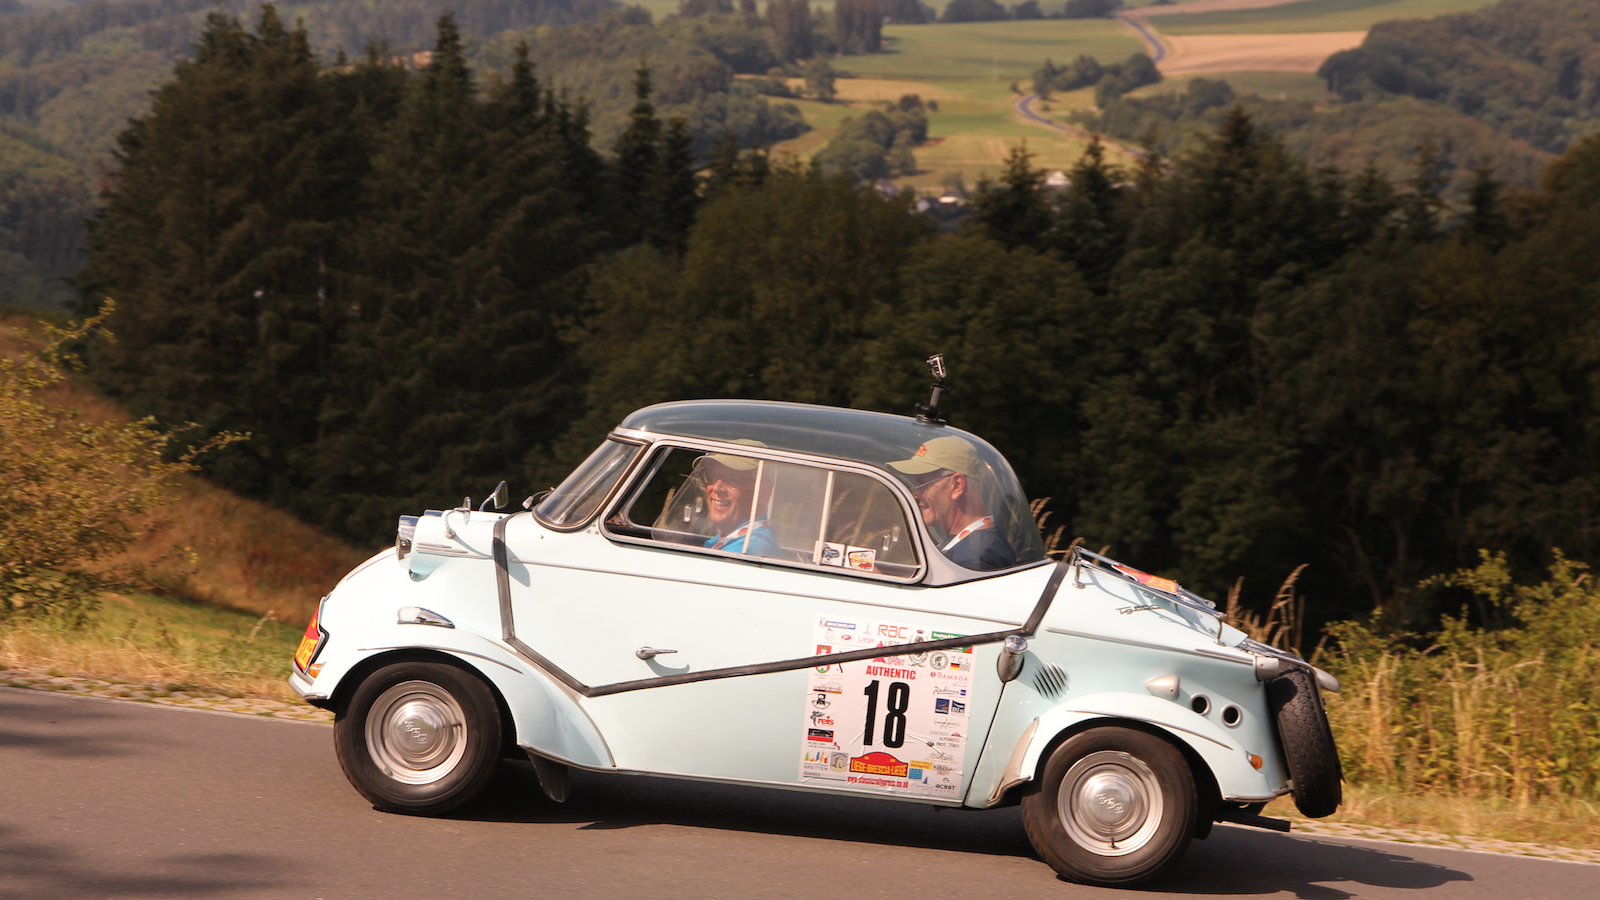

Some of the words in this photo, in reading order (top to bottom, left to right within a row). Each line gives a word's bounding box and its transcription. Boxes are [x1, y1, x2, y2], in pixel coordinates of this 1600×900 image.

[866, 665, 916, 680] AUTHENTIC
[937, 672, 968, 681] RAMADA
[863, 680, 910, 748] 18
[818, 716, 835, 725] reis
